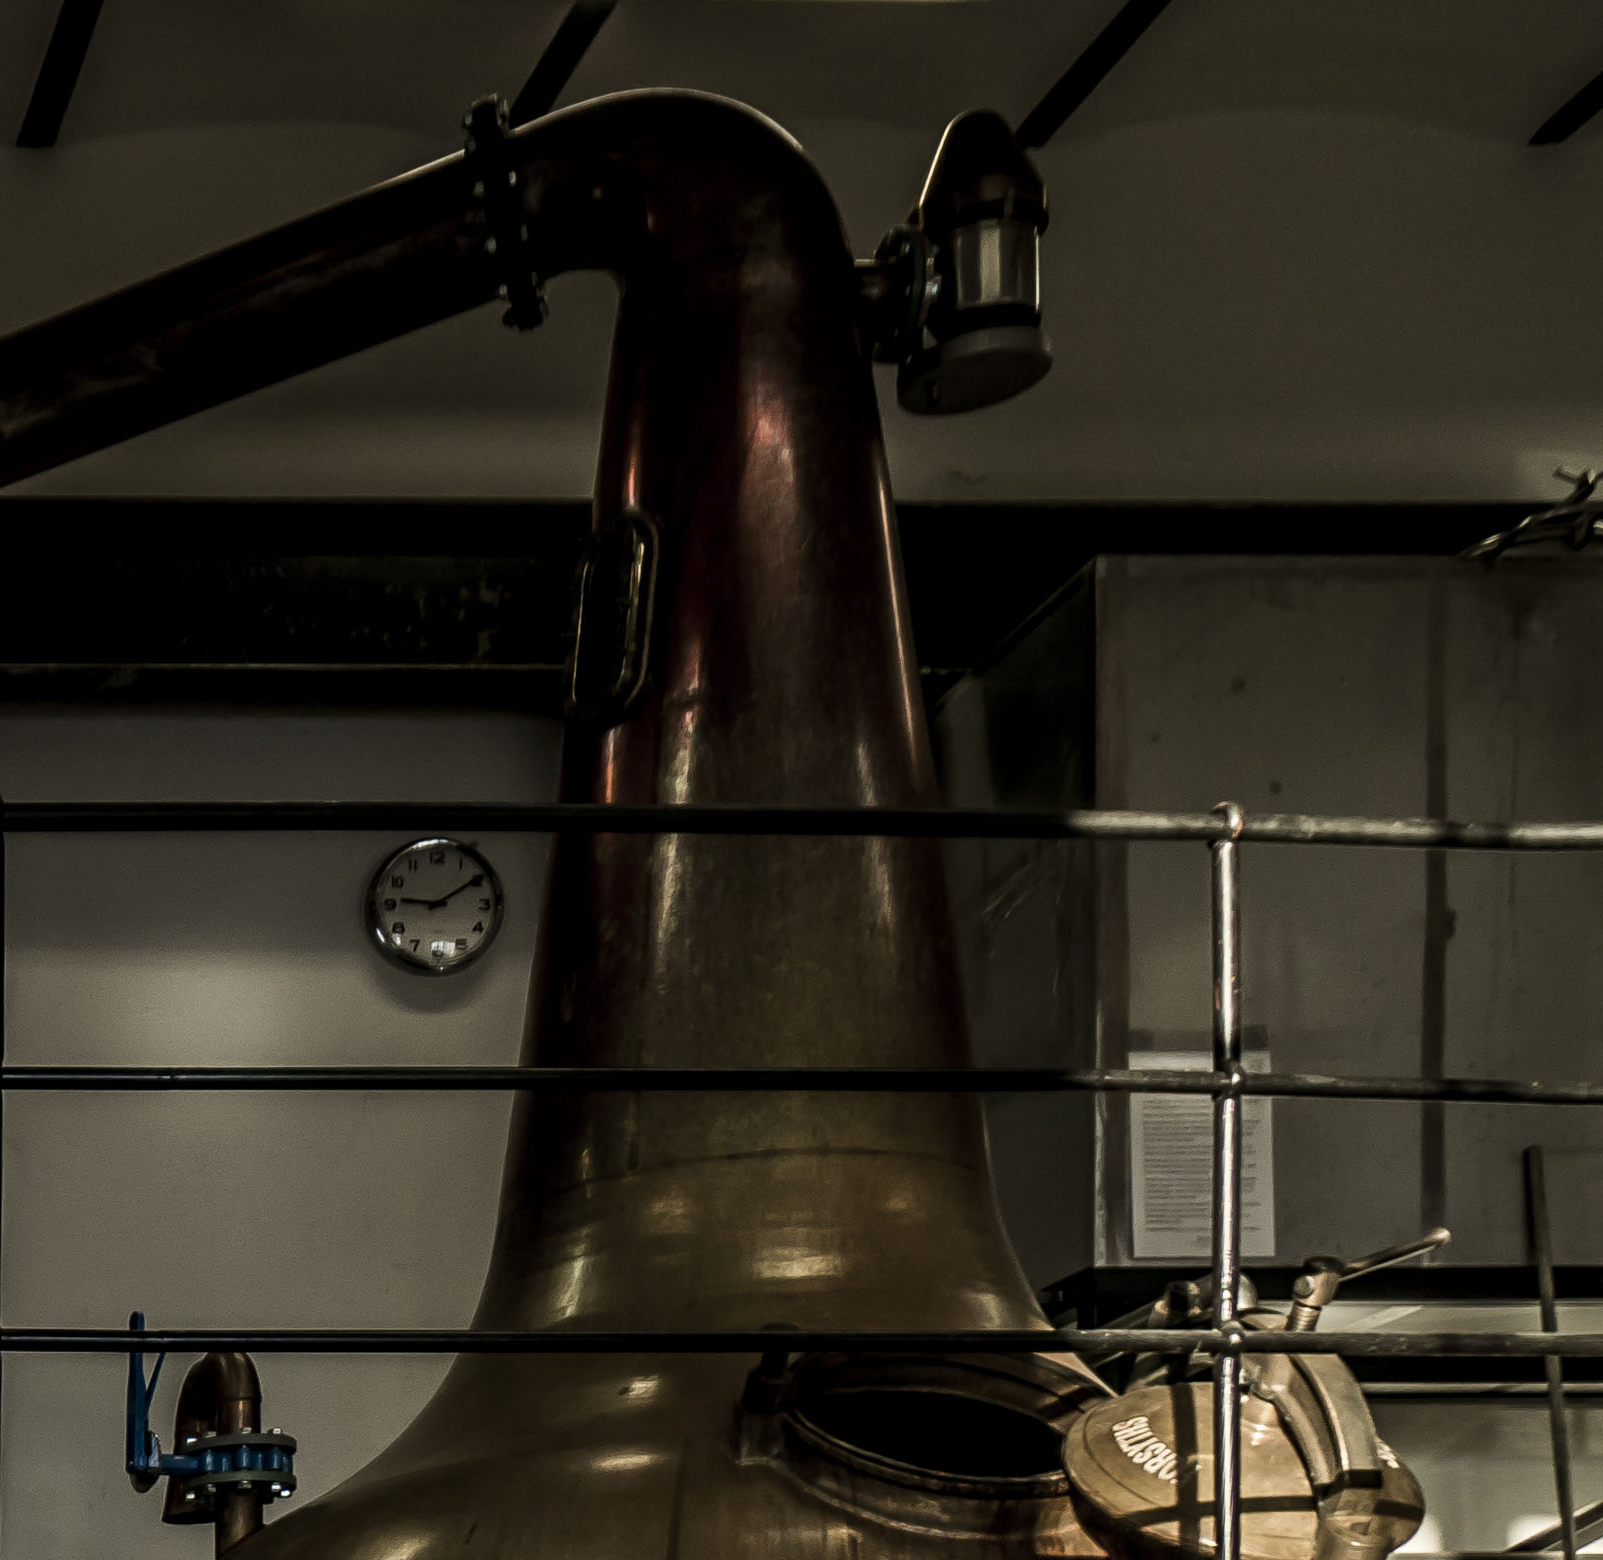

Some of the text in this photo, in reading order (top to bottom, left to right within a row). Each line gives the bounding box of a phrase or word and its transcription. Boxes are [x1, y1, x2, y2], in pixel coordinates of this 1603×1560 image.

[429, 851, 445, 864] 12
[408, 859, 417, 871] 11
[392, 876, 404, 888] 10
[384, 898, 397, 911] 9
[478, 899, 491, 911] 3
[473, 921, 484, 933] 4
[410, 939, 421, 953] 7
[1112, 1416, 1179, 1485] ORSYTHS
